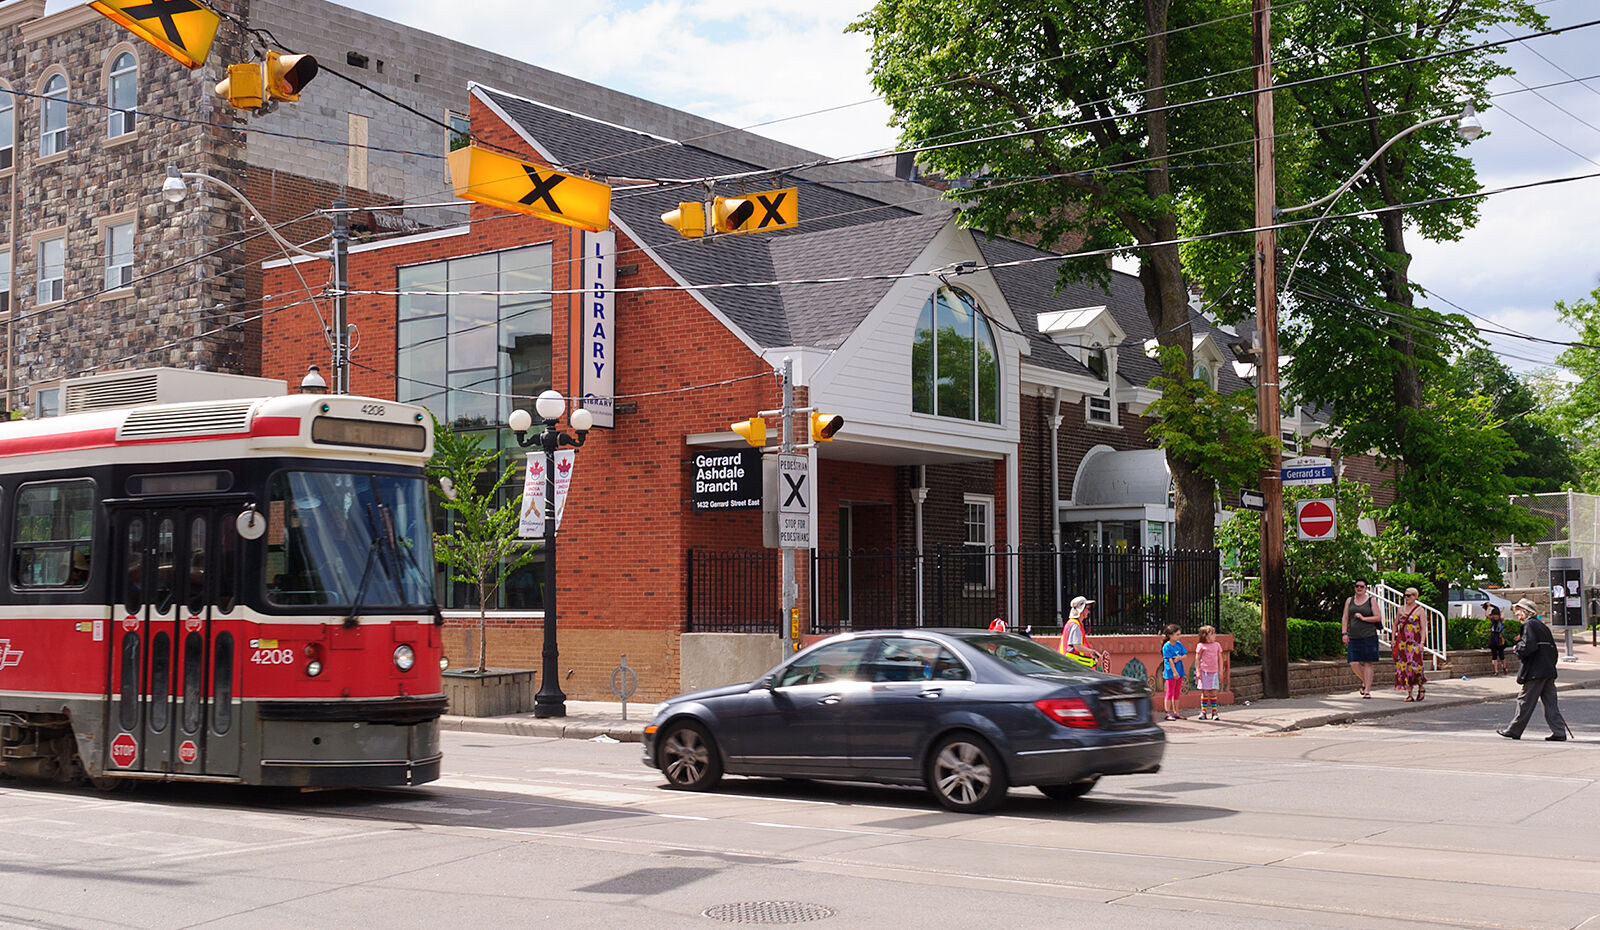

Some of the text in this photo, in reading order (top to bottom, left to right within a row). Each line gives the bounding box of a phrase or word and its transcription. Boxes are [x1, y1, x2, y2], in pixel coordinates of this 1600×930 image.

[592, 242, 606, 379] LIBRARY
[360, 404, 386, 416] 4208
[696, 453, 742, 468] Gerrard
[696, 466, 745, 480] Ashdale
[1287, 469, 1314, 478] Gerrard
[1321, 468, 1326, 477] E
[696, 479, 738, 493] Branch
[783, 473, 807, 508] X
[710, 500, 729, 508] Gerrard
[730, 499, 747, 507] Street
[747, 498, 760, 506] East
[785, 518, 806, 529] STOP FOR
[250, 649, 294, 665] 4208
[113, 745, 135, 756] STOP
